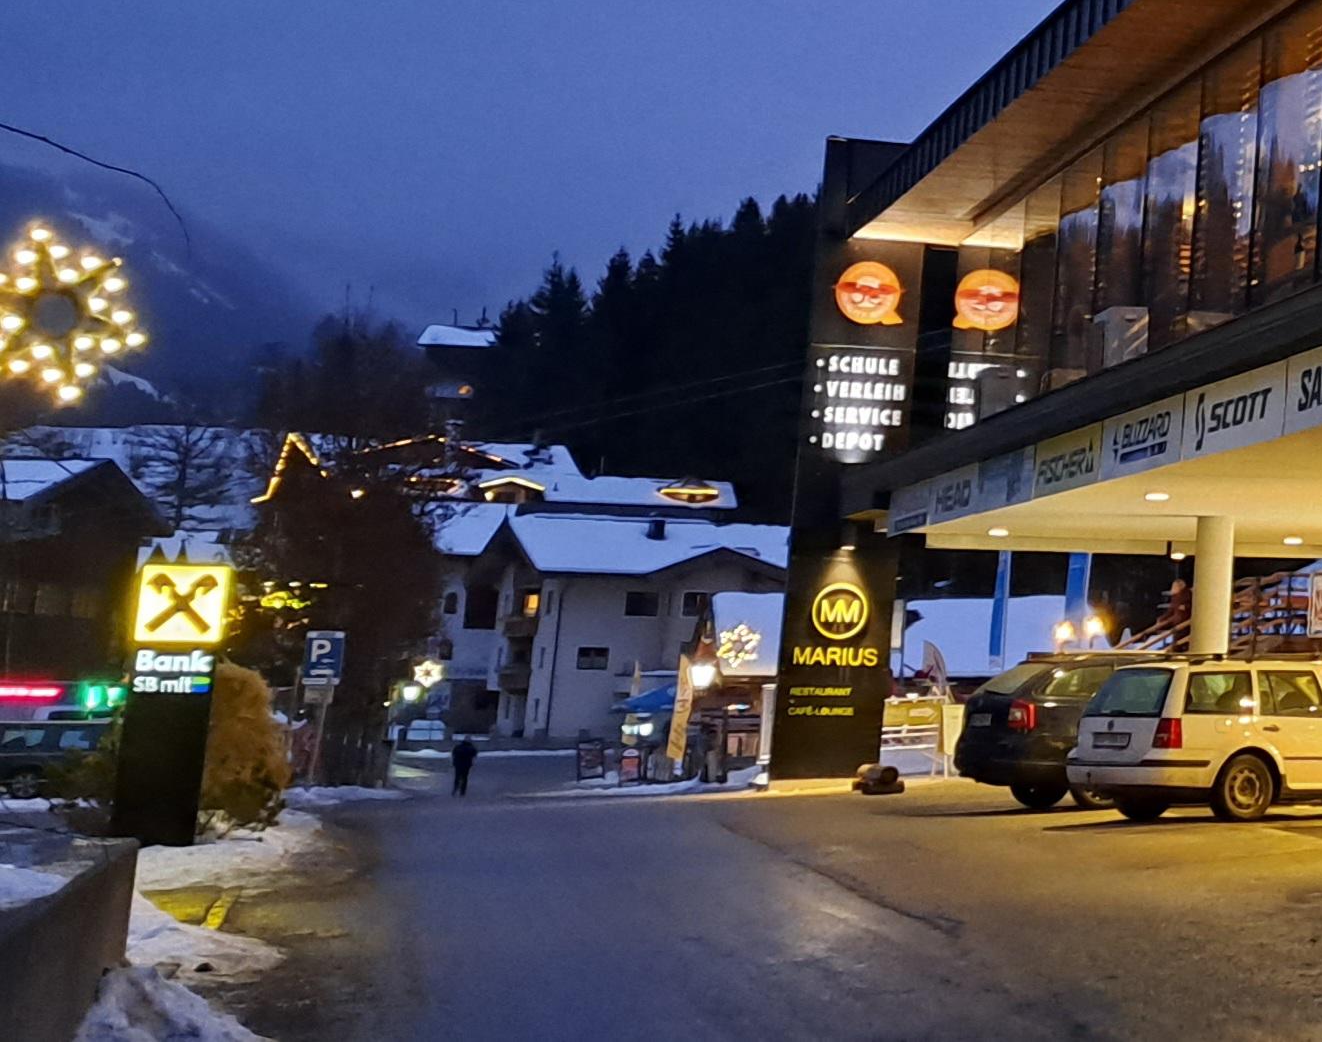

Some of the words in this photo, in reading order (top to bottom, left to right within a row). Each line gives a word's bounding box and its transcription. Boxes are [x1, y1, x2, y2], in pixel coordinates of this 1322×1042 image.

[828, 356, 900, 376] SCHULE
[826, 381, 907, 401] VERLEIH
[823, 407, 902, 427] SERVICE
[1207, 387, 1273, 434] SCOTT
[821, 432, 885, 452] DEPOT
[934, 479, 972, 514] HEAD
[820, 599, 861, 623] MM
[135, 649, 214, 673] Bank
[311, 639, 331, 662] P
[792, 646, 878, 667] MARIUS
[132, 676, 156, 693] SB
[159, 675, 192, 693] mit
